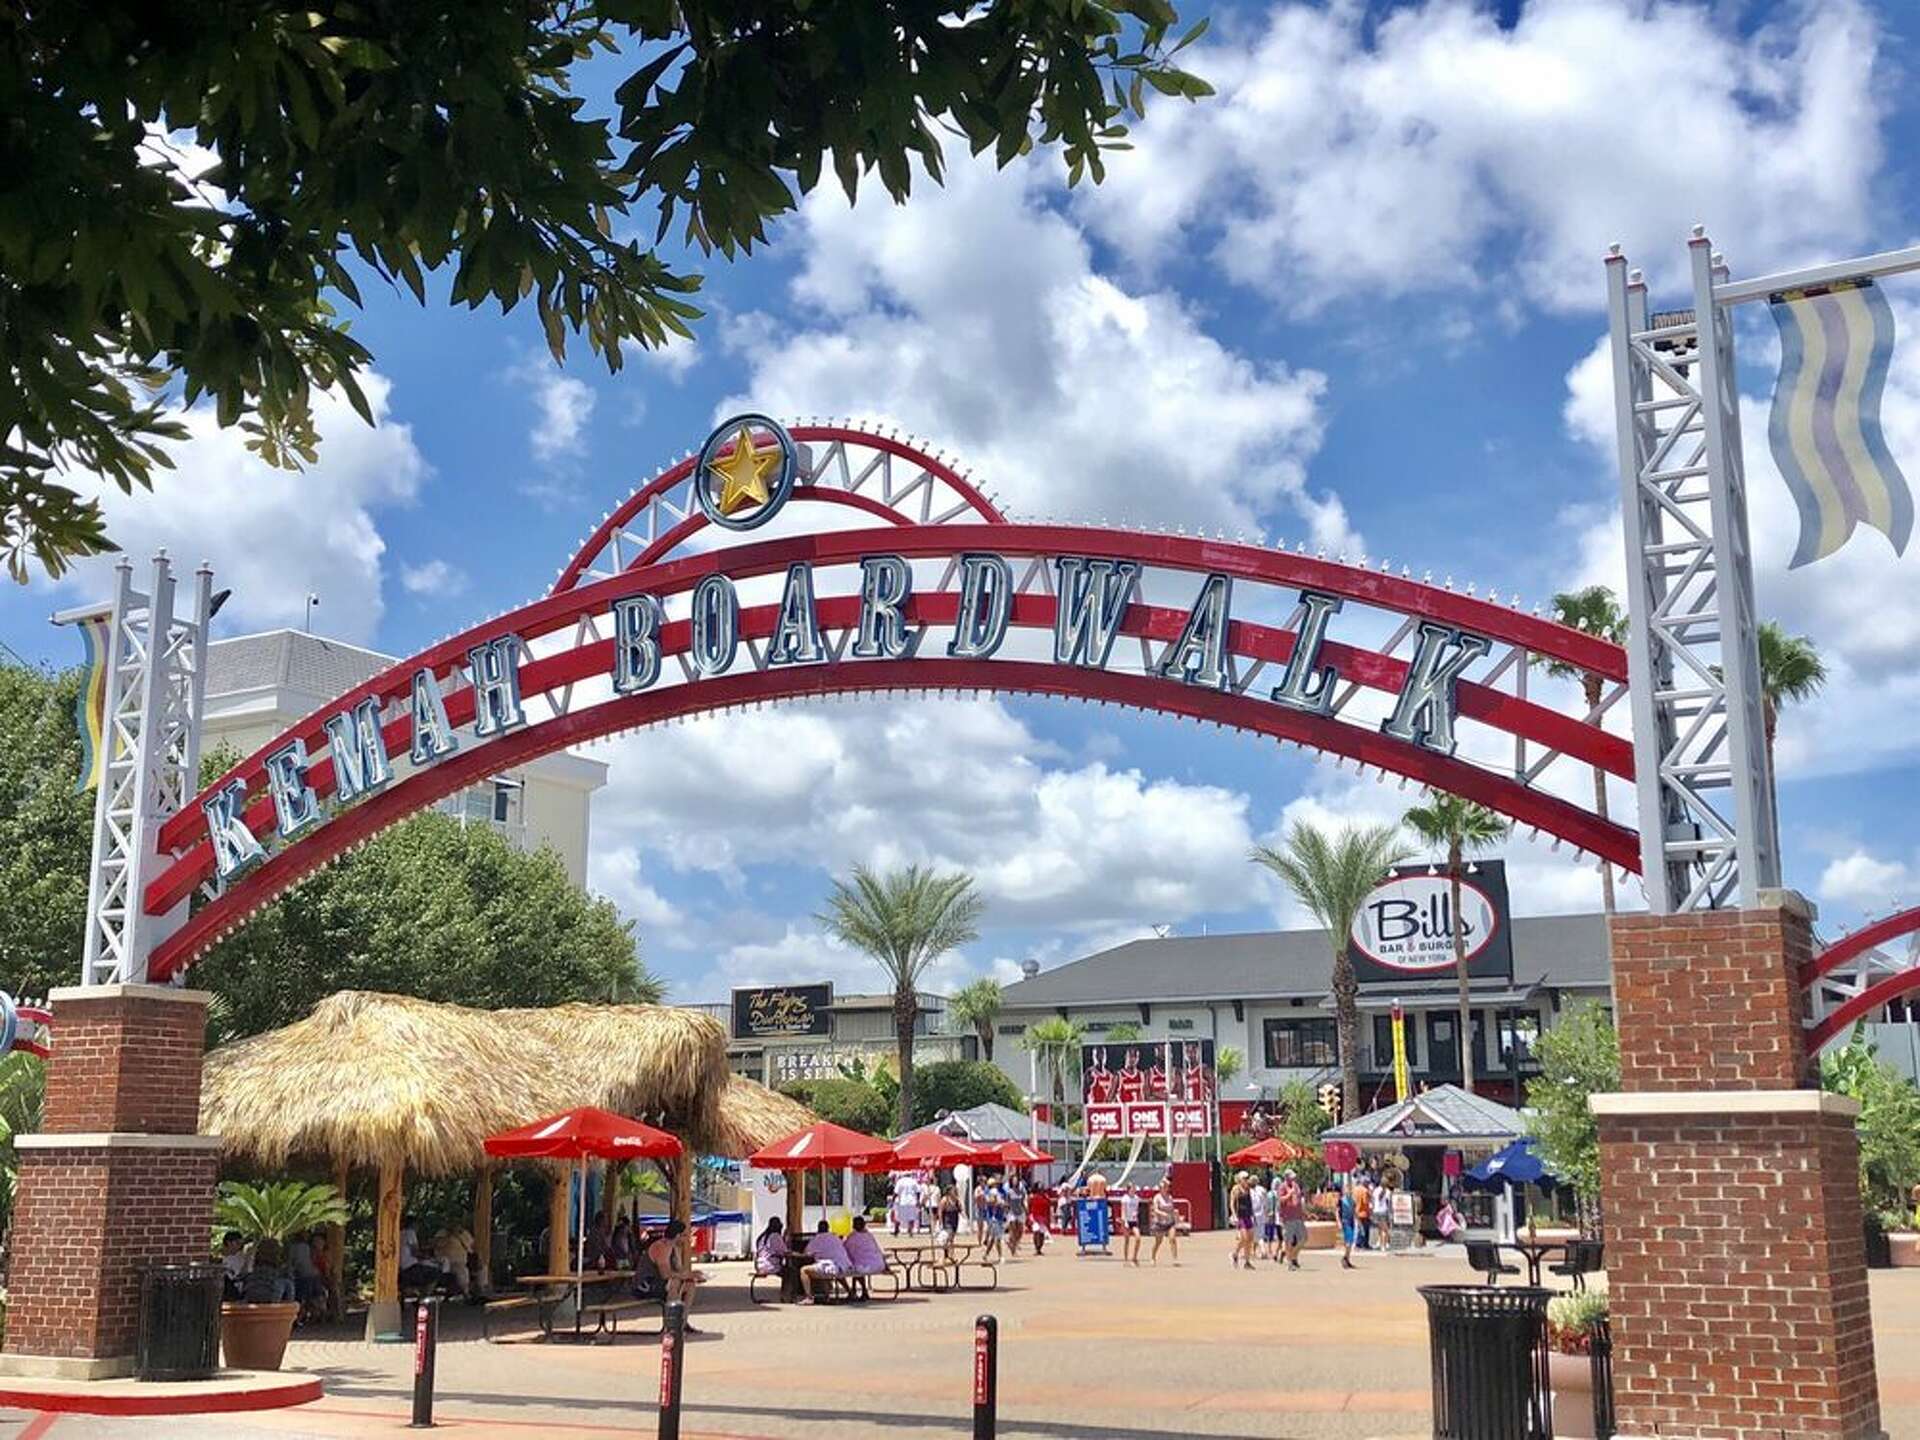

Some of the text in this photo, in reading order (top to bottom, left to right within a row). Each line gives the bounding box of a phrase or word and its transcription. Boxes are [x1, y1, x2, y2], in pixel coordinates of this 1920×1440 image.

[203, 554, 1493, 880] KEMAH BOARDWALK
[1380, 943, 1404, 953] BAR
[1419, 940, 1470, 951] BURGR
[1408, 955, 1425, 963] NEW
[1428, 954, 1446, 962] YORK
[781, 1068, 797, 1081] IS
[1090, 1112, 1117, 1123] ONE
[1132, 1110, 1159, 1122] ONE
